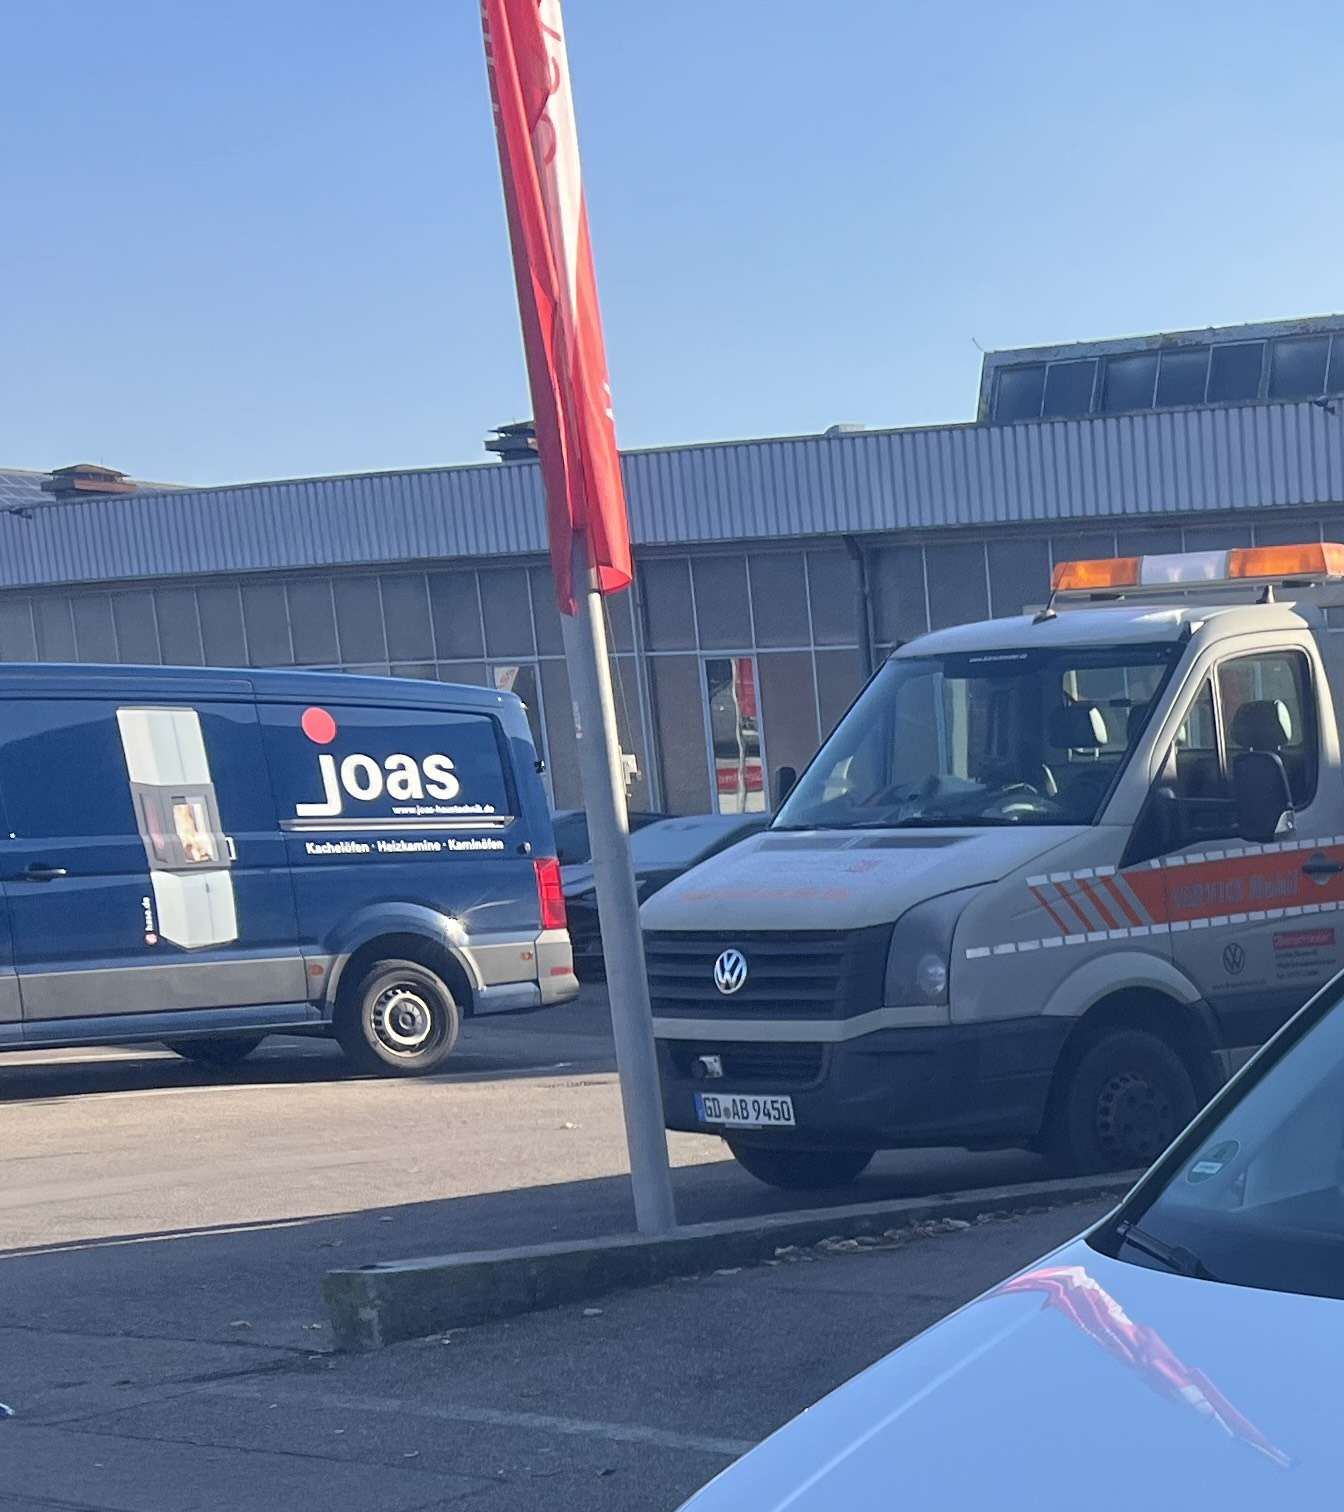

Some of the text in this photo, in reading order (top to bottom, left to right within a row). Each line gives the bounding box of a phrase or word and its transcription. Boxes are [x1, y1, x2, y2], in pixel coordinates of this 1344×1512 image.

[295, 706, 460, 818] joas
[305, 838, 504, 855] Kachelöfen Heizkamine Kaminöfen
[703, 1096, 792, 1122] GD AB 9450
